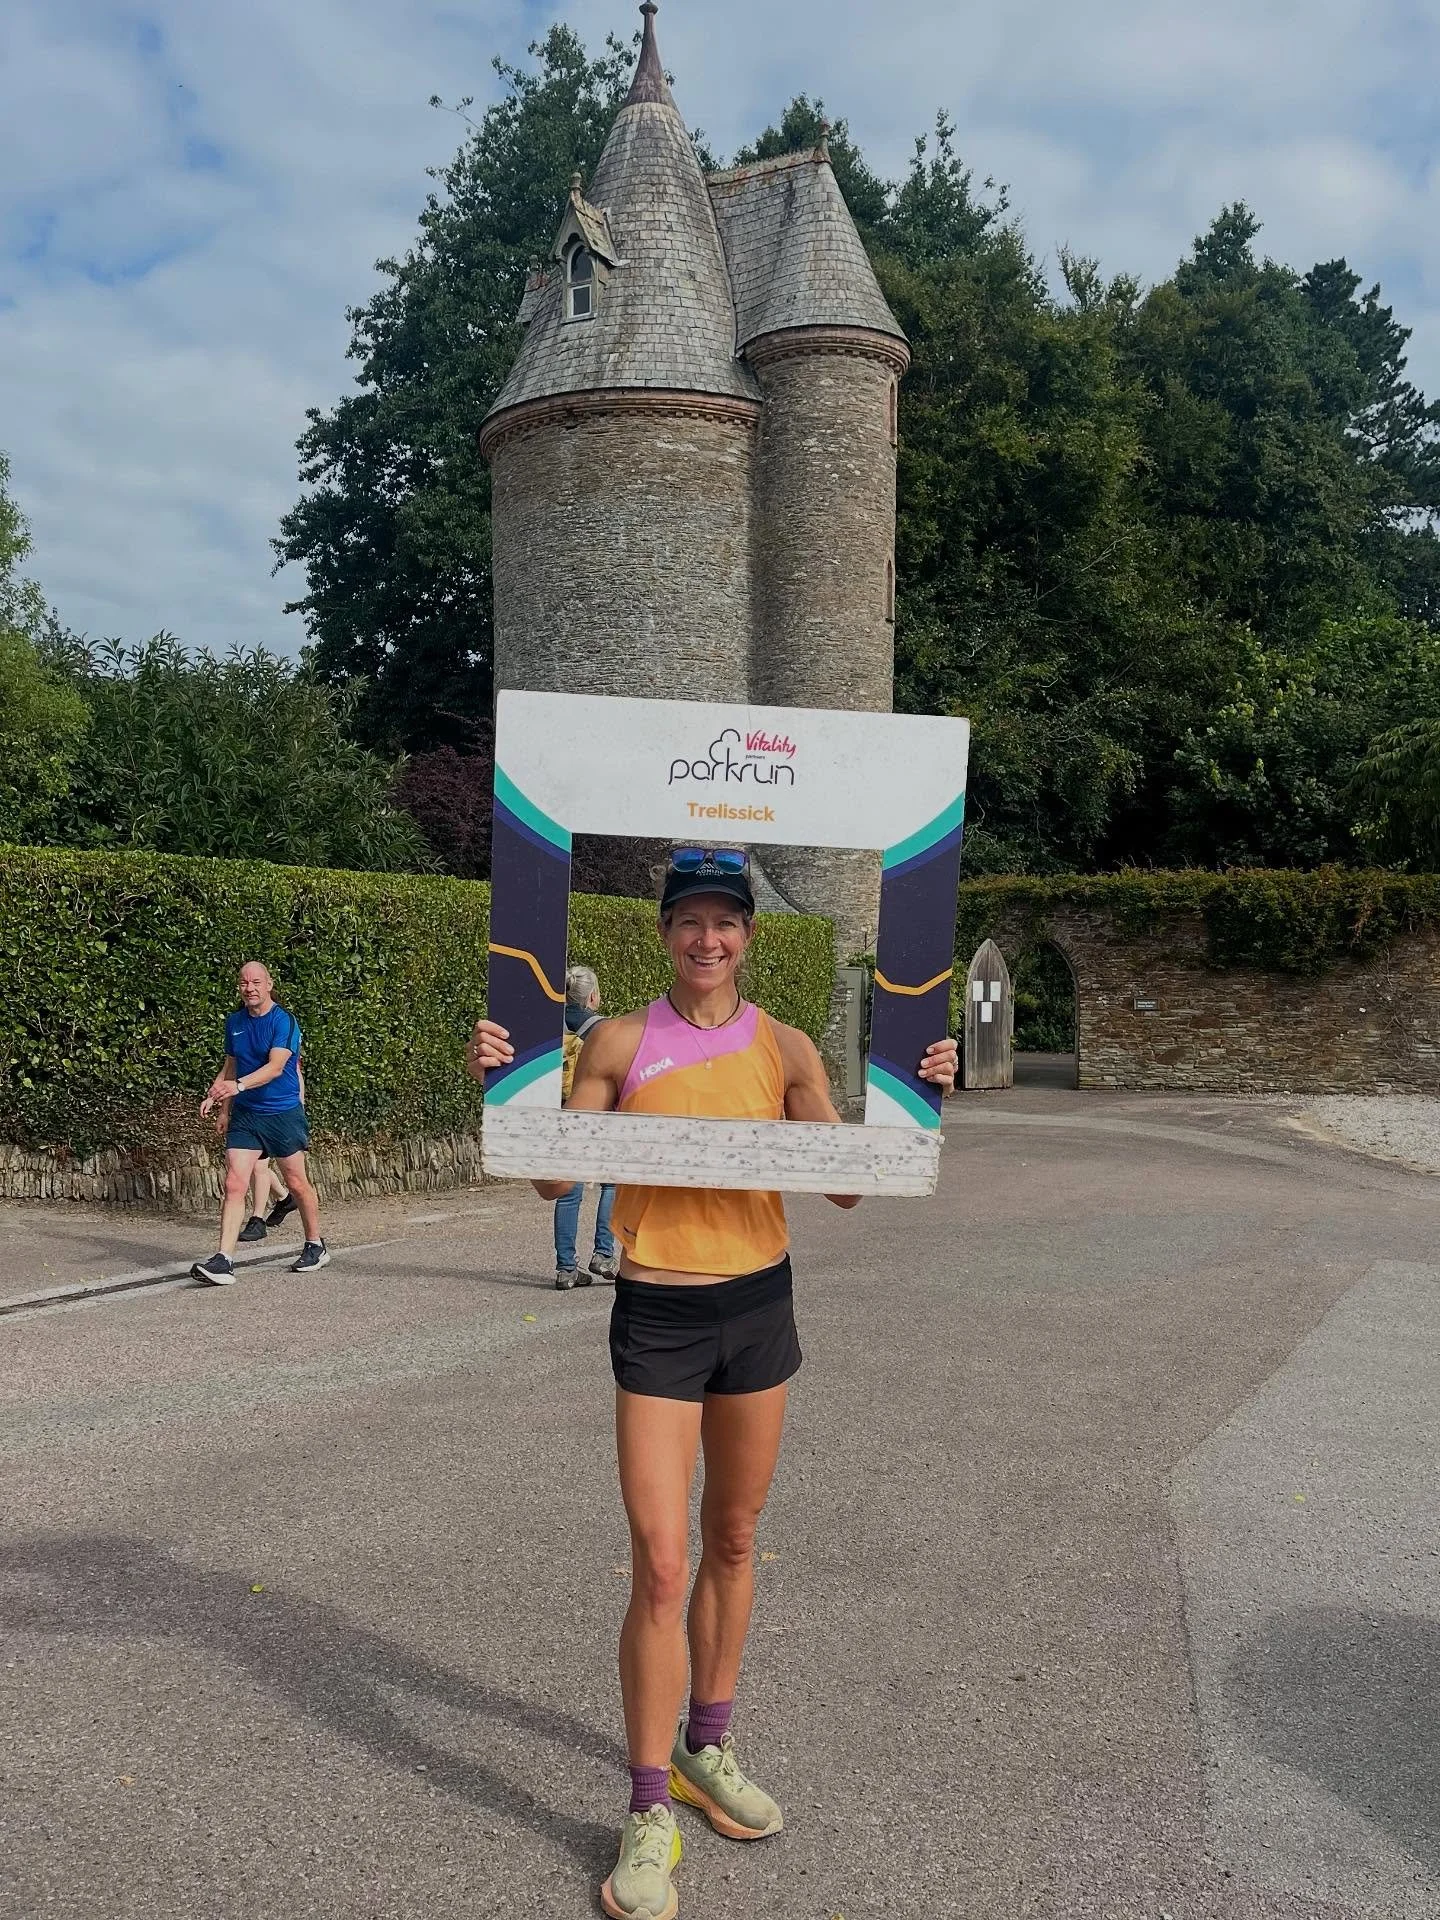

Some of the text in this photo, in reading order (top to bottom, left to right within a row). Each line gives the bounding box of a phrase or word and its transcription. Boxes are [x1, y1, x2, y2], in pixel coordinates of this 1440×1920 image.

[746, 730, 796, 759] Vitality
[668, 746, 795, 786] parkrun
[687, 802, 775, 822] Trelissick
[639, 1057, 674, 1081] HOKA
